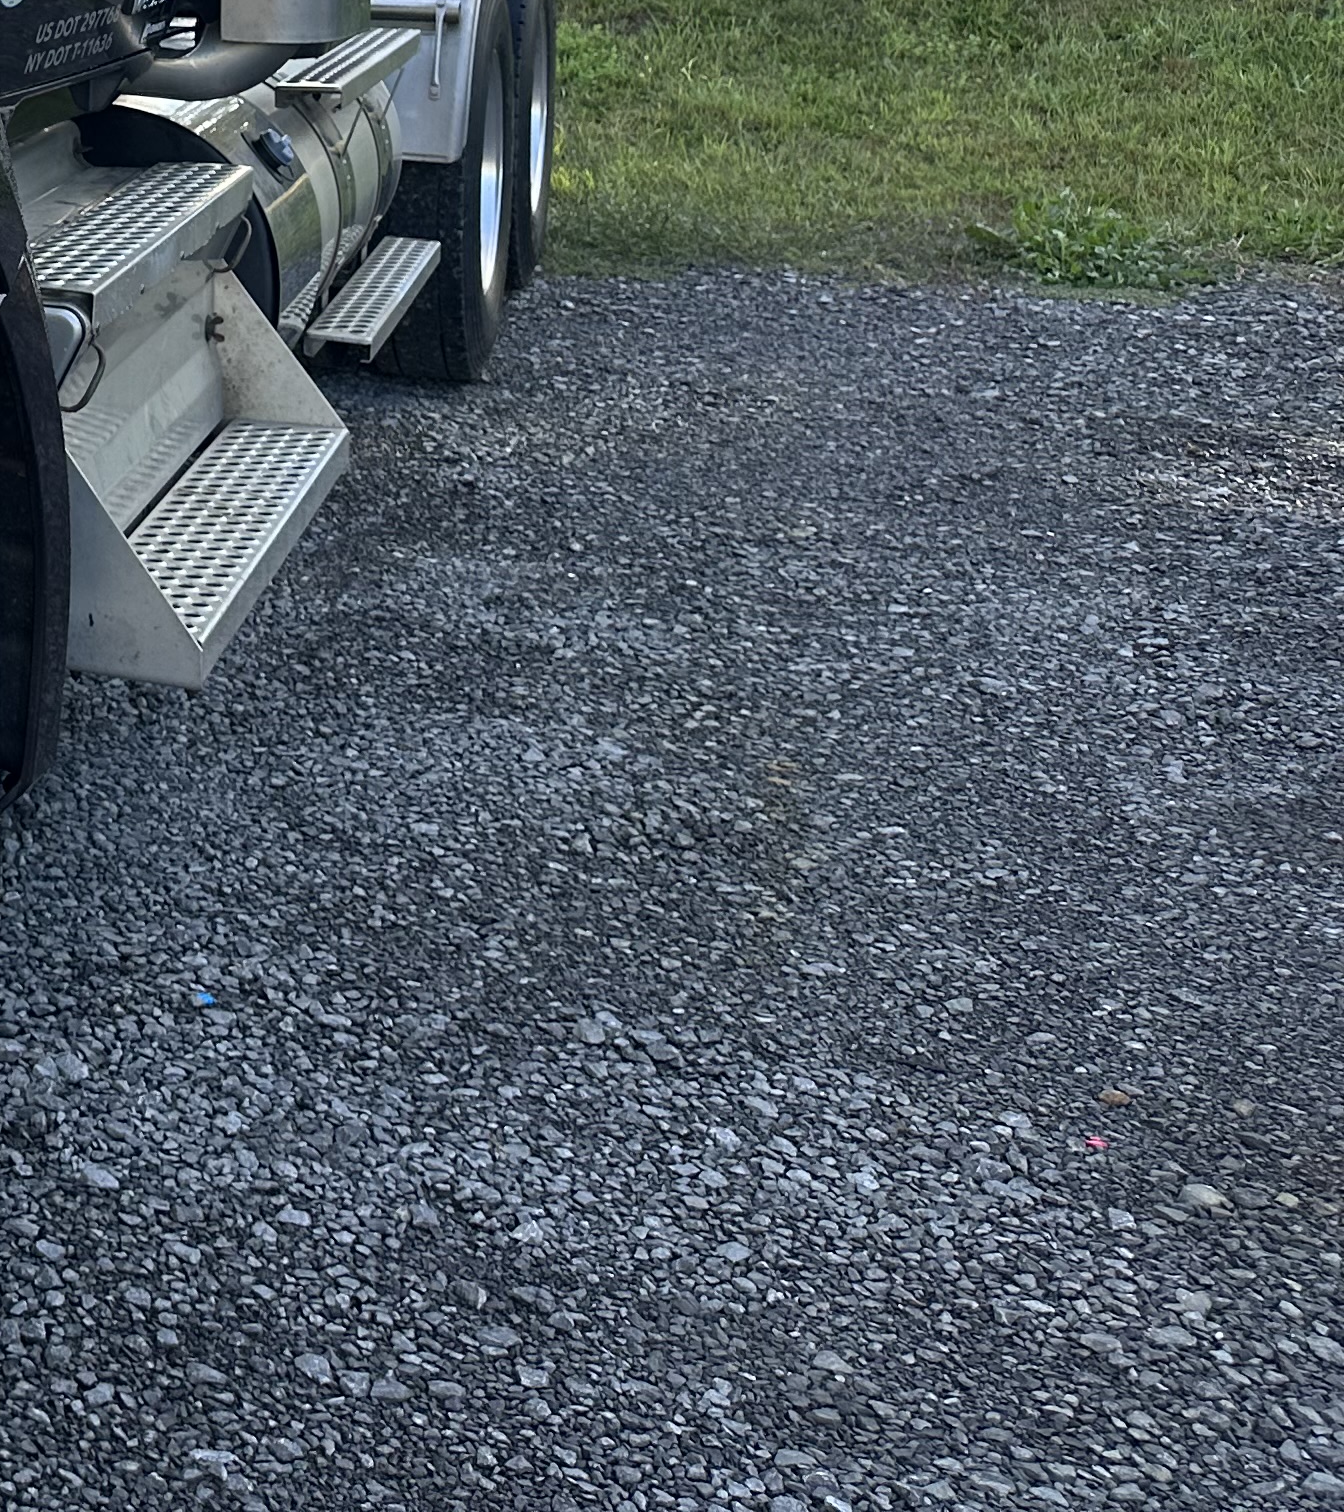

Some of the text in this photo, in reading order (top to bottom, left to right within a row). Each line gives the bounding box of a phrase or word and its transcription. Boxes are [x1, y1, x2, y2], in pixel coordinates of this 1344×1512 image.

[36, 23, 54, 43] US
[55, 16, 81, 39] DOT
[24, 51, 46, 74] NY
[44, 44, 71, 70] DOT
